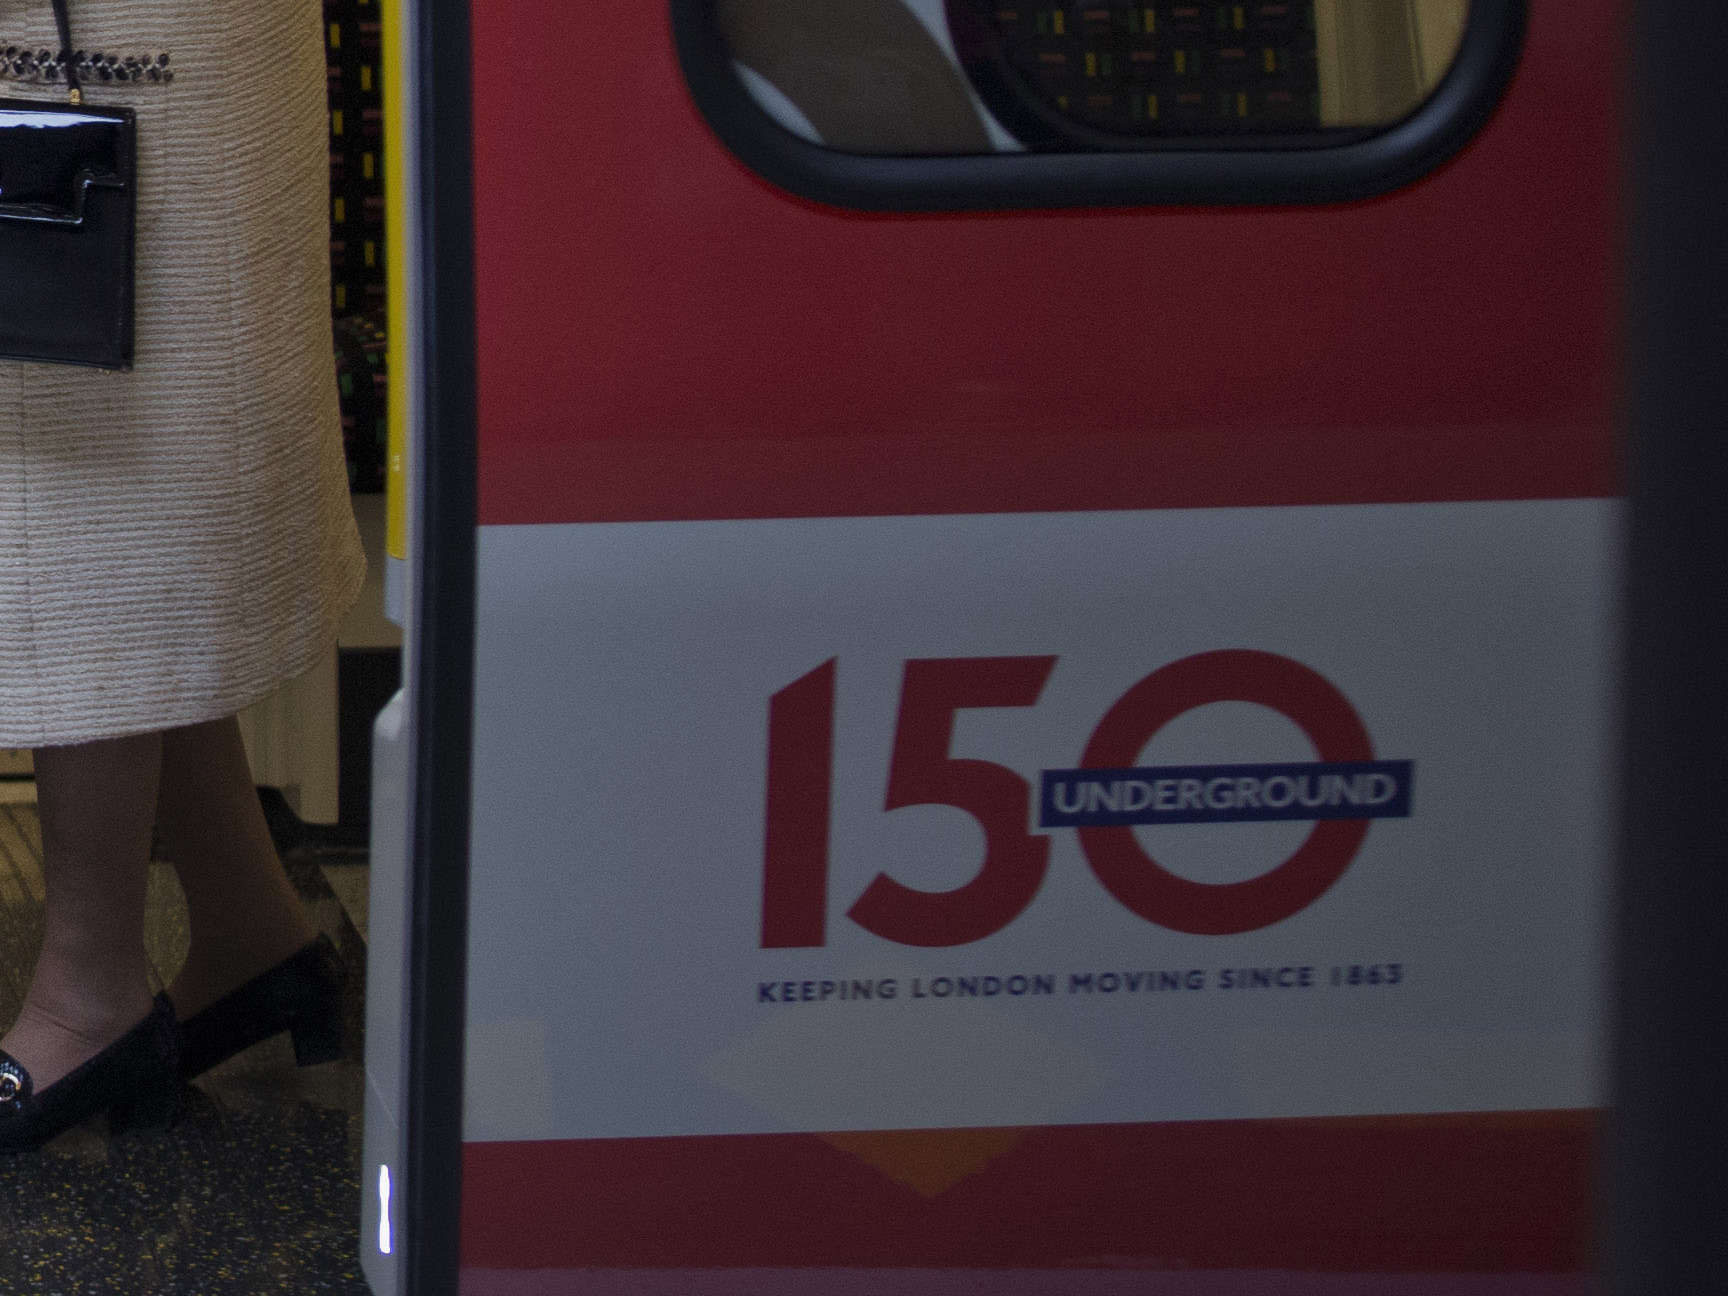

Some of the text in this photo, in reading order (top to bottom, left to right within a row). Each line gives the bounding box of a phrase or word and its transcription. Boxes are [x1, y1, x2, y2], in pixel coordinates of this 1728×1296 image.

[1051, 773, 1399, 815] UNDERGROUND
[757, 962, 1405, 1004] KEEPING LONDON MOVING SINCE 1863
